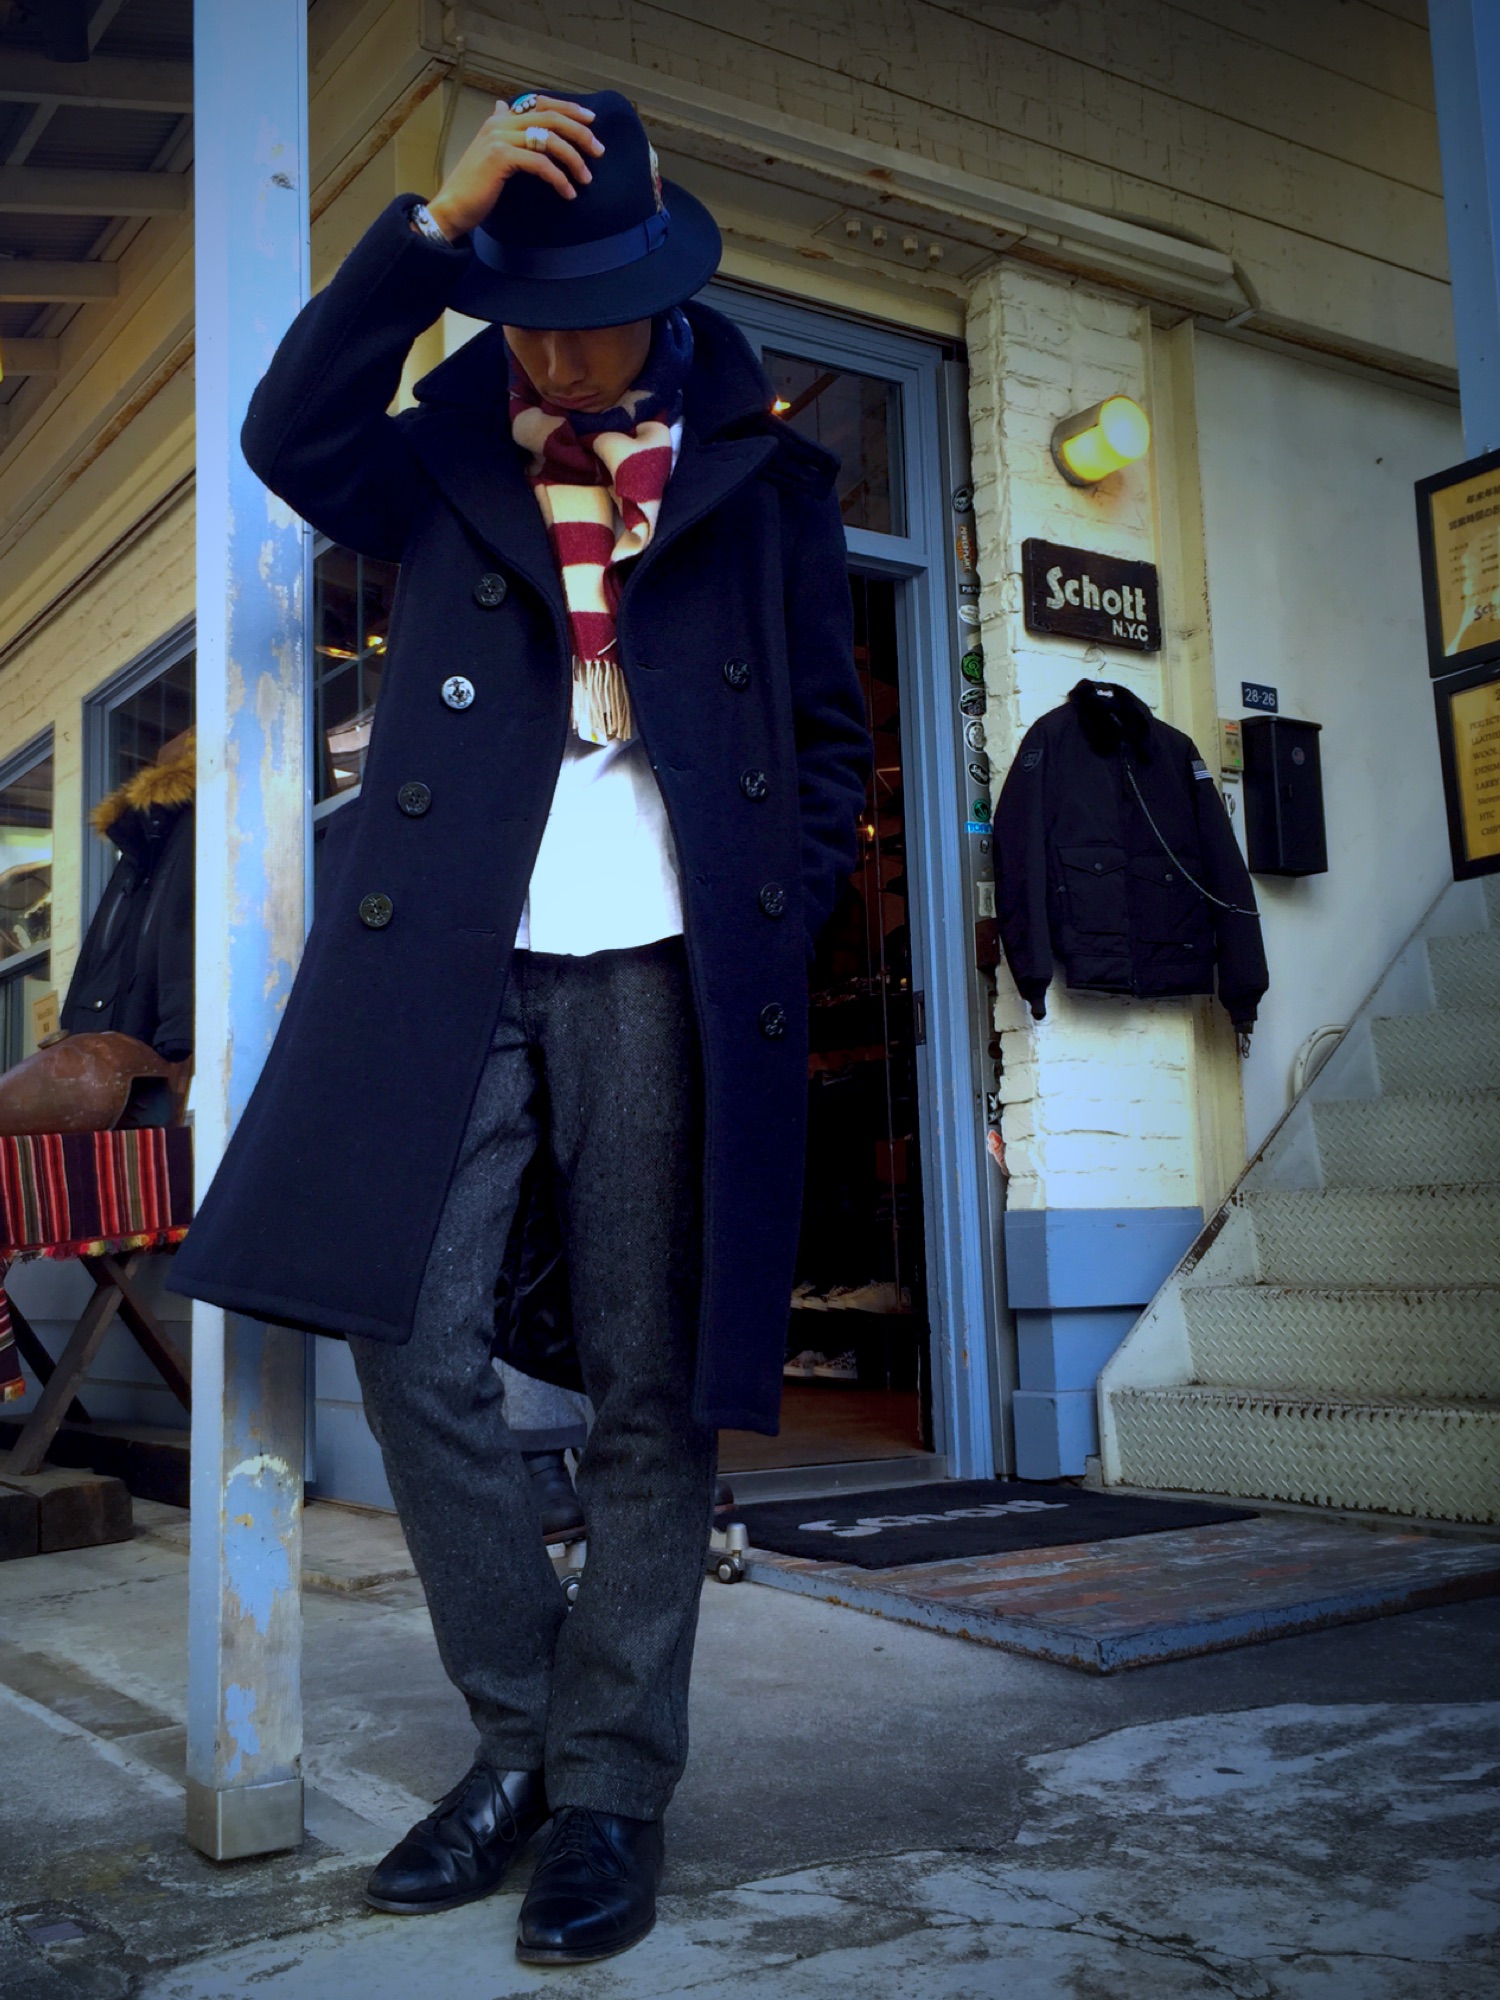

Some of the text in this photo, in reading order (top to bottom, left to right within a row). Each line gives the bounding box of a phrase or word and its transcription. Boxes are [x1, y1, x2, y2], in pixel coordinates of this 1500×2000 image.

[1046, 566, 1147, 621] Schott
[1112, 619, 1149, 642] N.Y.C
[1244, 688, 1276, 707] 28-26
